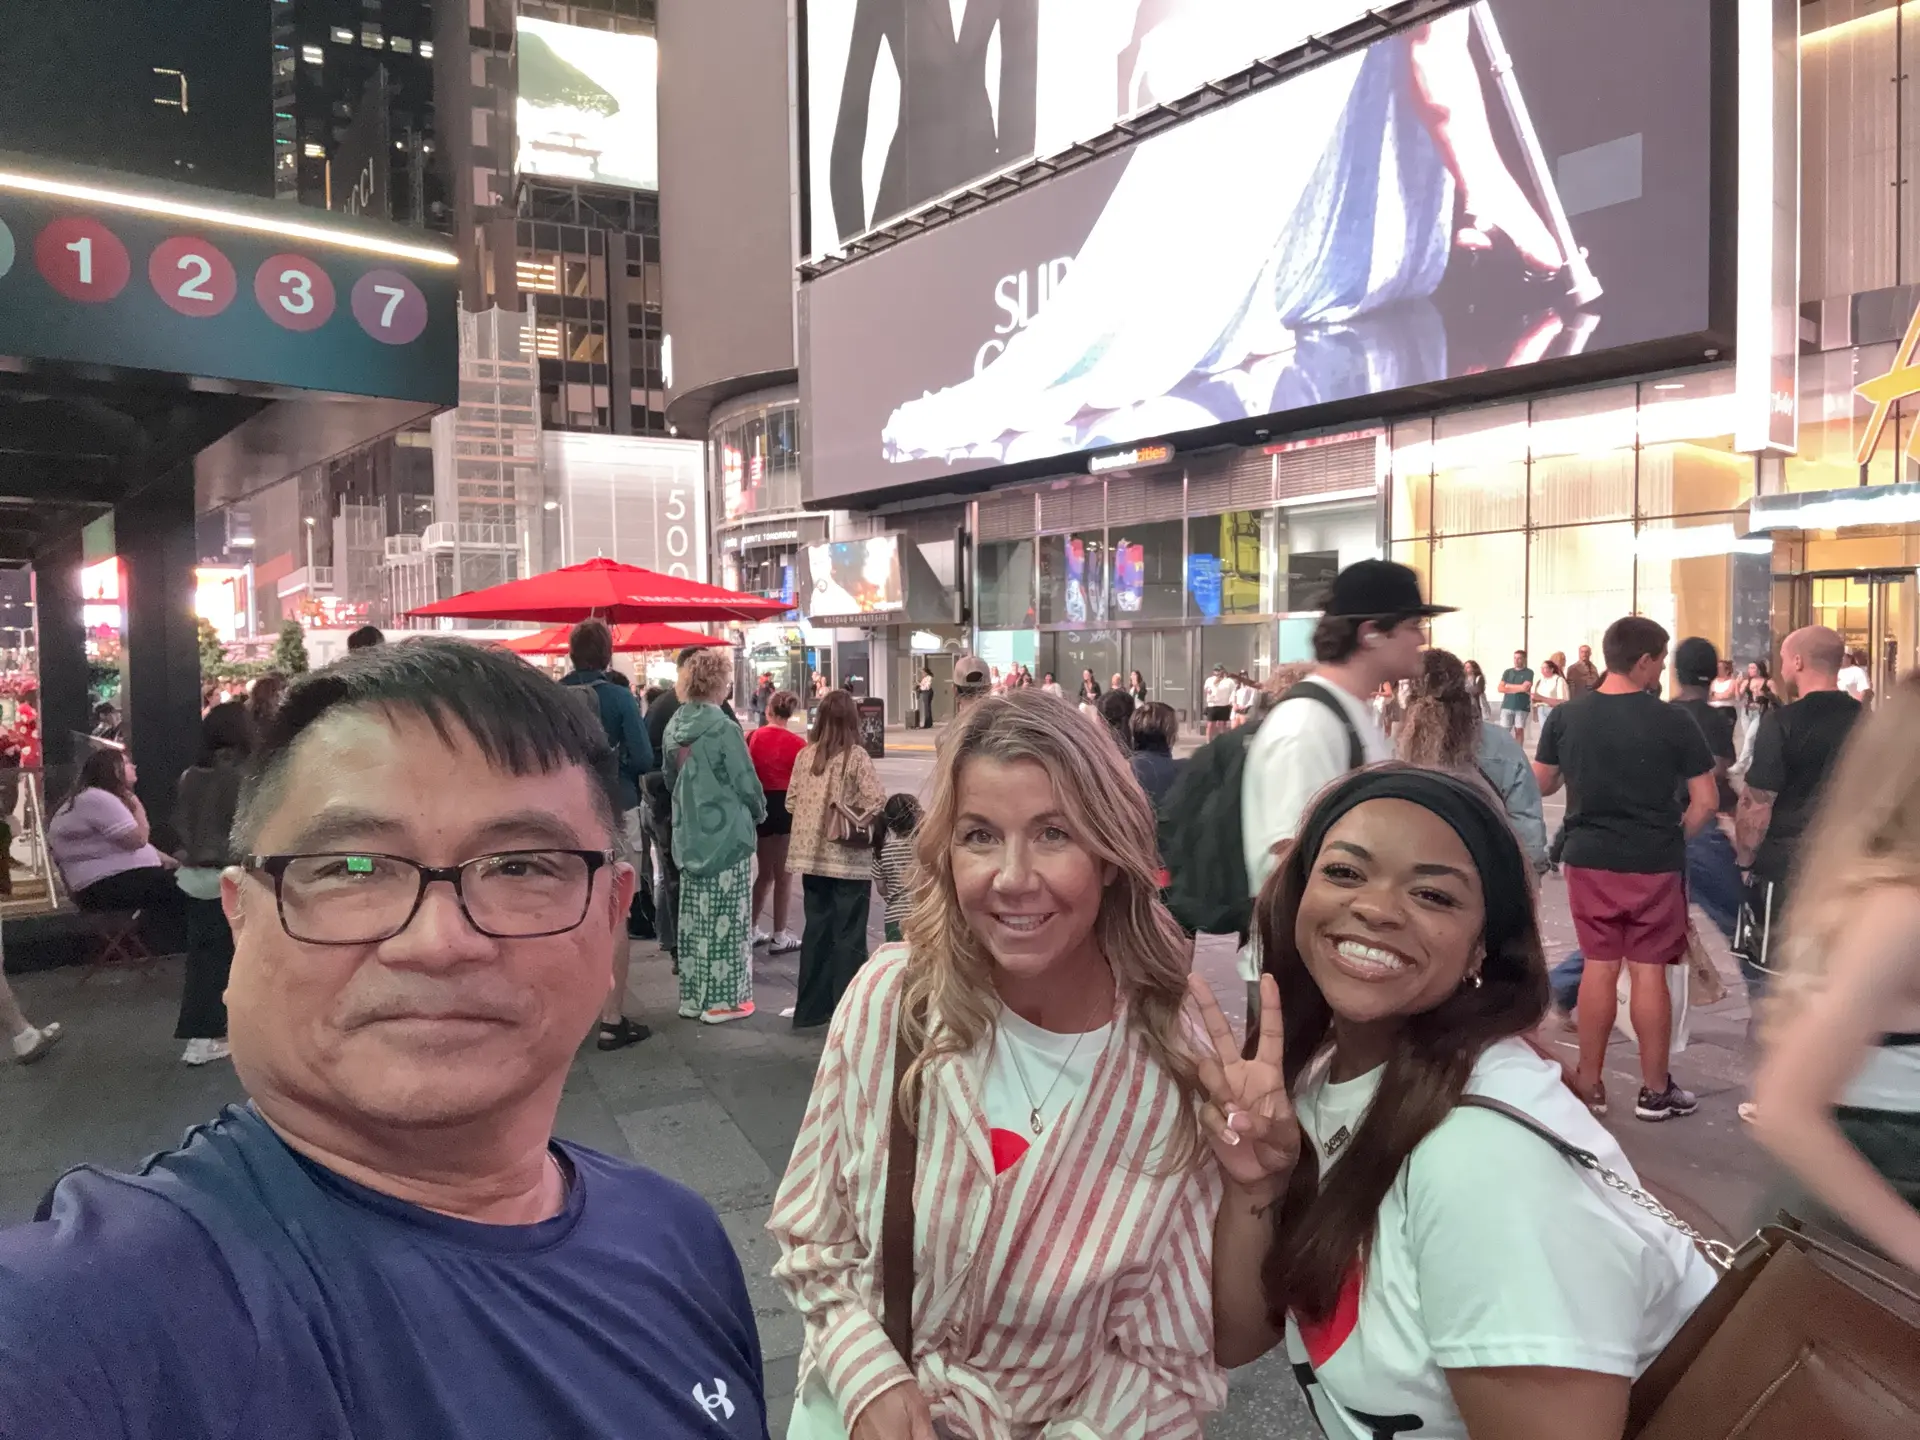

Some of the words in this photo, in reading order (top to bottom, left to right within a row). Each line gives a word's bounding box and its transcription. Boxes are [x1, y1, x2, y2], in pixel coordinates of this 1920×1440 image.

[66, 237, 93, 284] 1
[177, 254, 214, 301] 2
[278, 269, 315, 315] 3
[373, 285, 405, 328] 7
